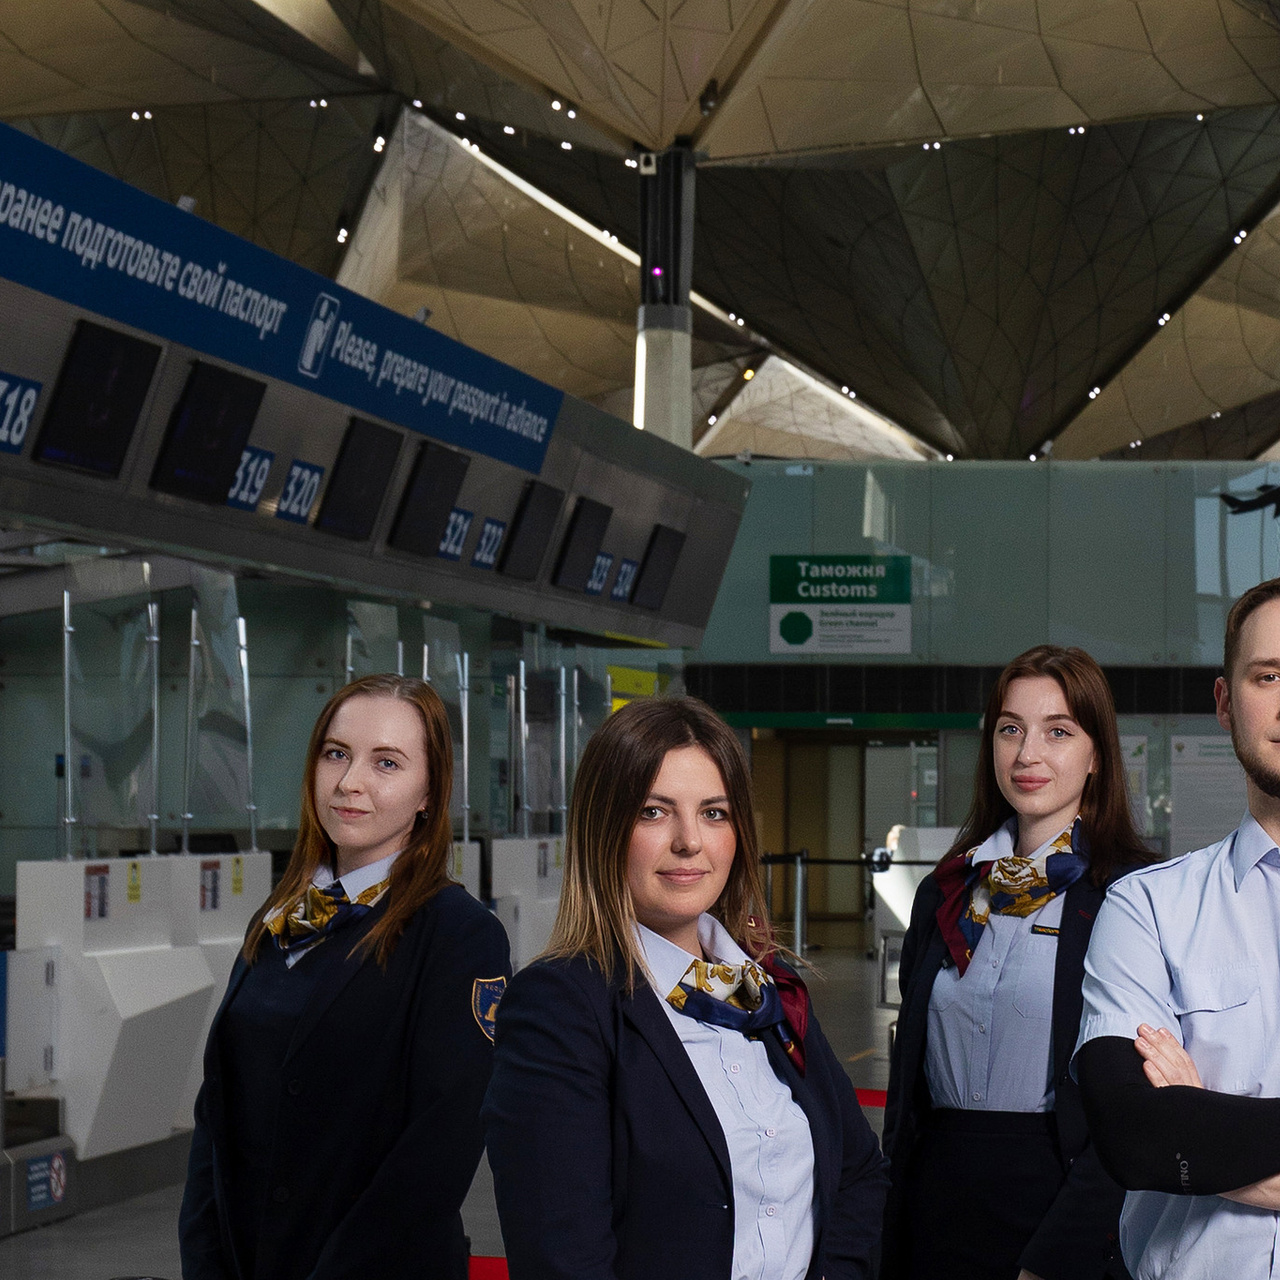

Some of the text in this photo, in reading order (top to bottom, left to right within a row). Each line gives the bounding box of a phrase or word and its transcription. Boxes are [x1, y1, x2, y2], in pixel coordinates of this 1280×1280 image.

[0, 179, 288, 340] ранее подготовьте свой паспорт
[331, 320, 379, 383] Please,
[376, 349, 431, 396] prepare
[421, 370, 456, 407] your
[448, 380, 500, 425] passport
[505, 399, 548, 443] advance
[0, 379, 37, 446] 18
[278, 464, 321, 518] 320
[439, 512, 473, 556] 321
[797, 561, 886, 578] Таможня
[797, 581, 878, 598] Customs
